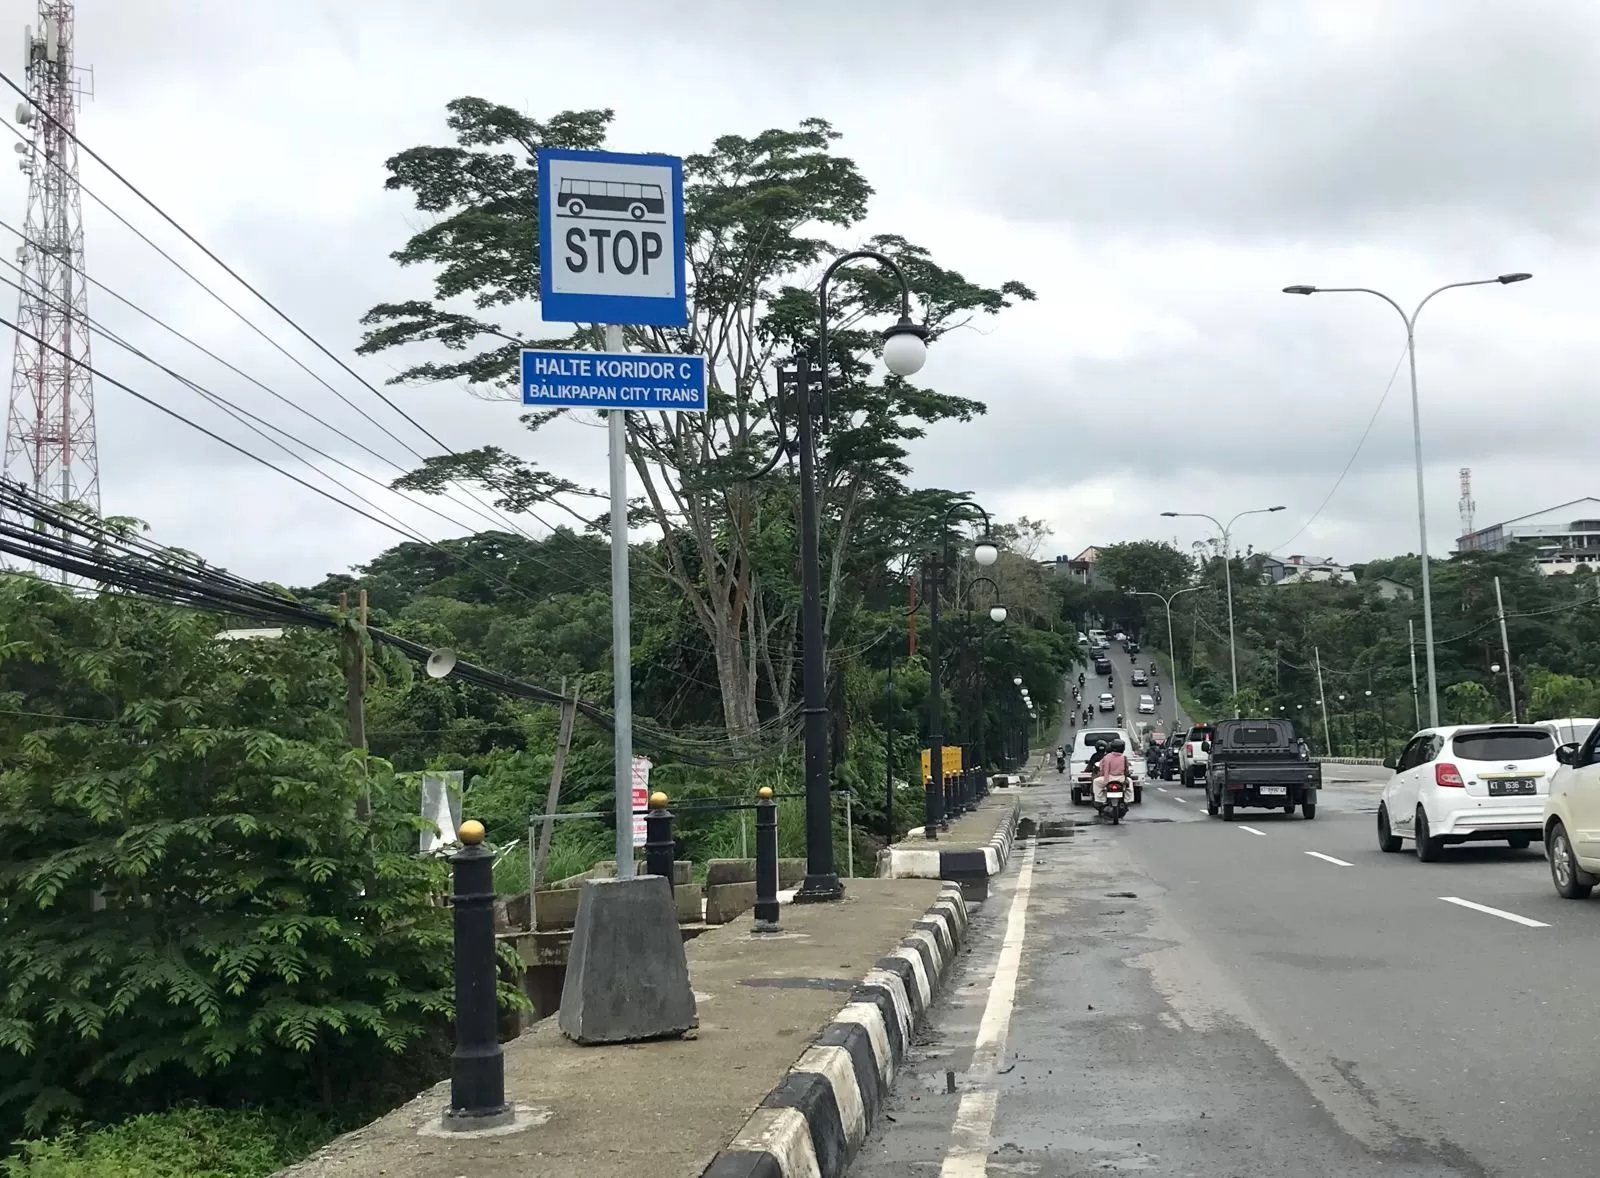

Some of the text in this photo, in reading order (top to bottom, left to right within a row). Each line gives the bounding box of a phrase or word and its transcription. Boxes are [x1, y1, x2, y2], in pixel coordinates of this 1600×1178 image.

[566, 228, 662, 275] STOP
[535, 358, 691, 380] HALTE KORIDOR C
[530, 384, 699, 402] BALIKPAPAN CITY TRANS
